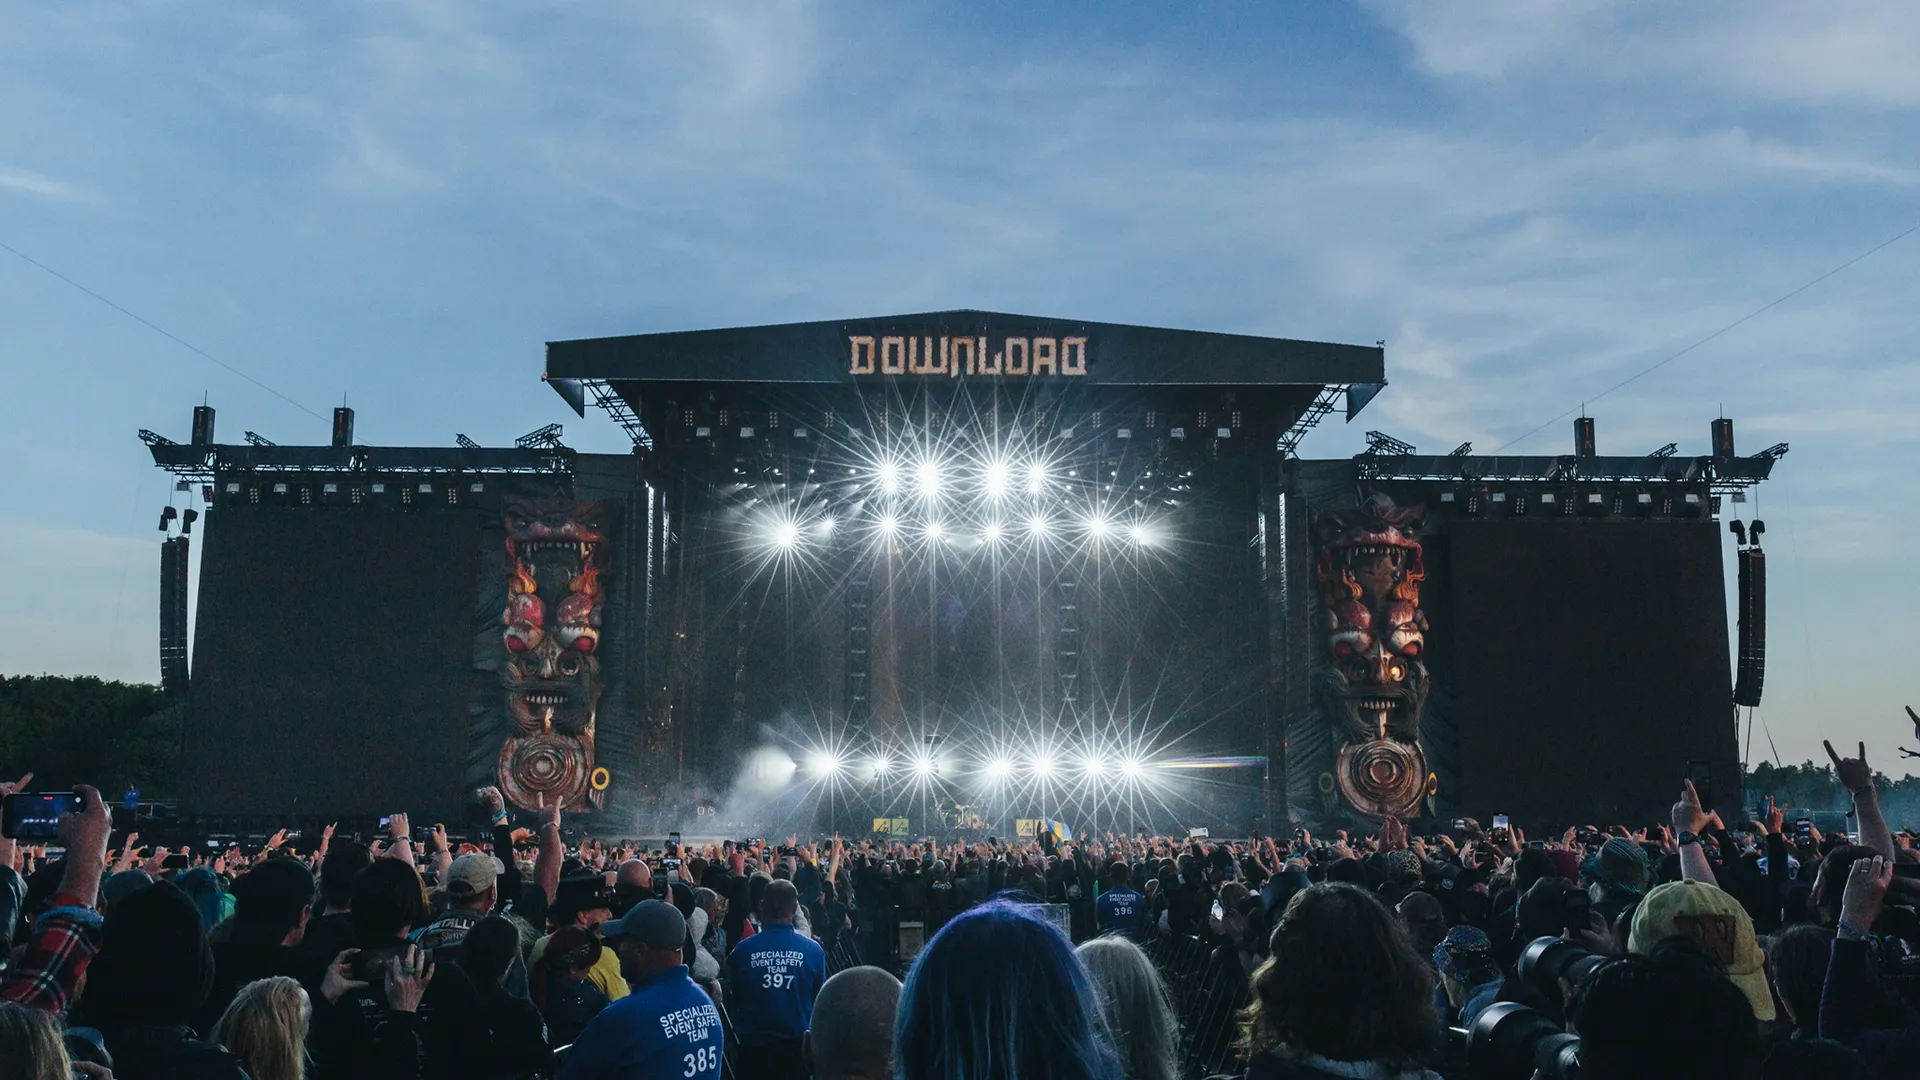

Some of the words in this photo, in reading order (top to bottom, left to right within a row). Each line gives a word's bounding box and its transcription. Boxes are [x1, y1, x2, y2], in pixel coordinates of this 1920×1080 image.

[849, 335, 1088, 378] DOWNLOAD
[1114, 907, 1132, 915] 396
[751, 951, 804, 960] SPECIALIZED
[751, 959, 774, 968] EVENT
[775, 958, 804, 968] SAFETY
[767, 966, 787, 974] TEAM
[762, 973, 794, 990] 397
[660, 1004, 716, 1027] SPECIALIZE
[664, 1019, 696, 1039] EVENT
[687, 1028, 709, 1043] TEAM
[683, 1045, 717, 1078] 385
